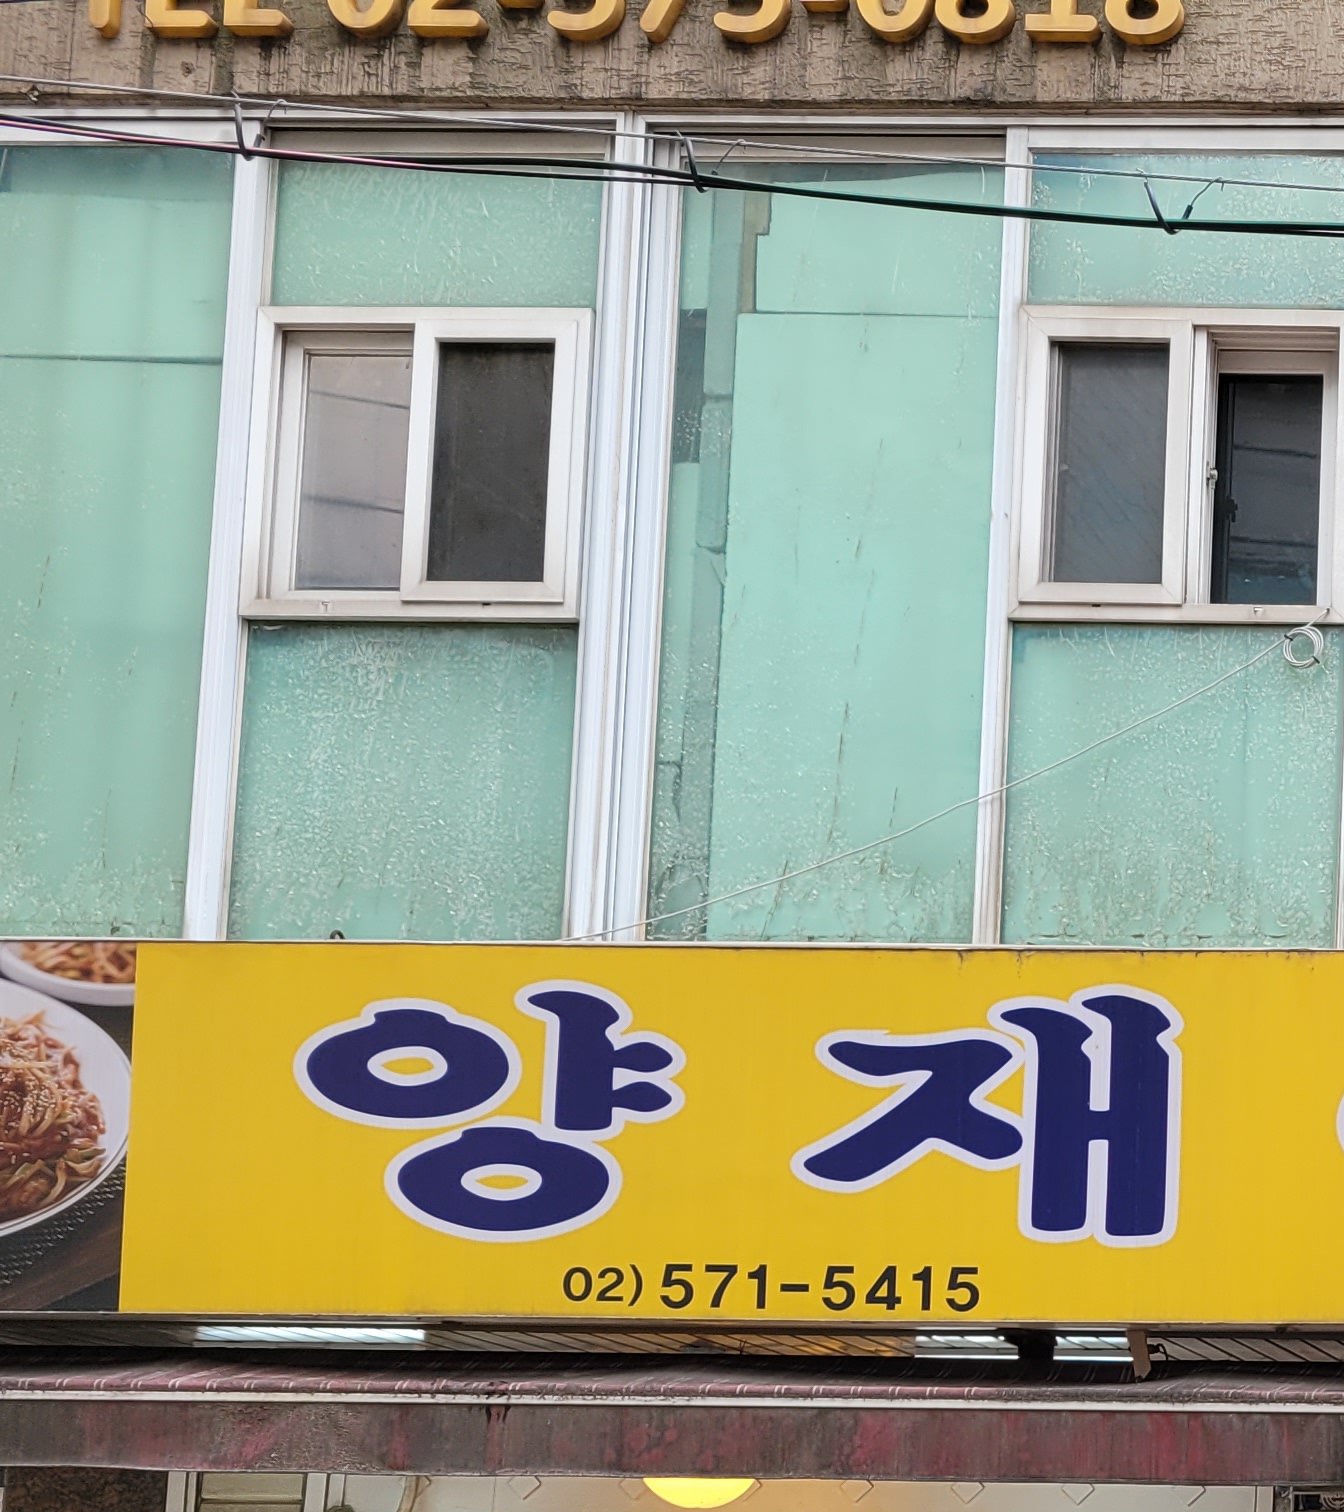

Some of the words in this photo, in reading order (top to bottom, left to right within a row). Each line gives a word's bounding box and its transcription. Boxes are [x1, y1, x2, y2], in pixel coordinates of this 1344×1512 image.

[296, 980, 1182, 1247] 양재
[562, 1264, 644, 1305] 02)
[659, 1264, 981, 1311] 571-5415
